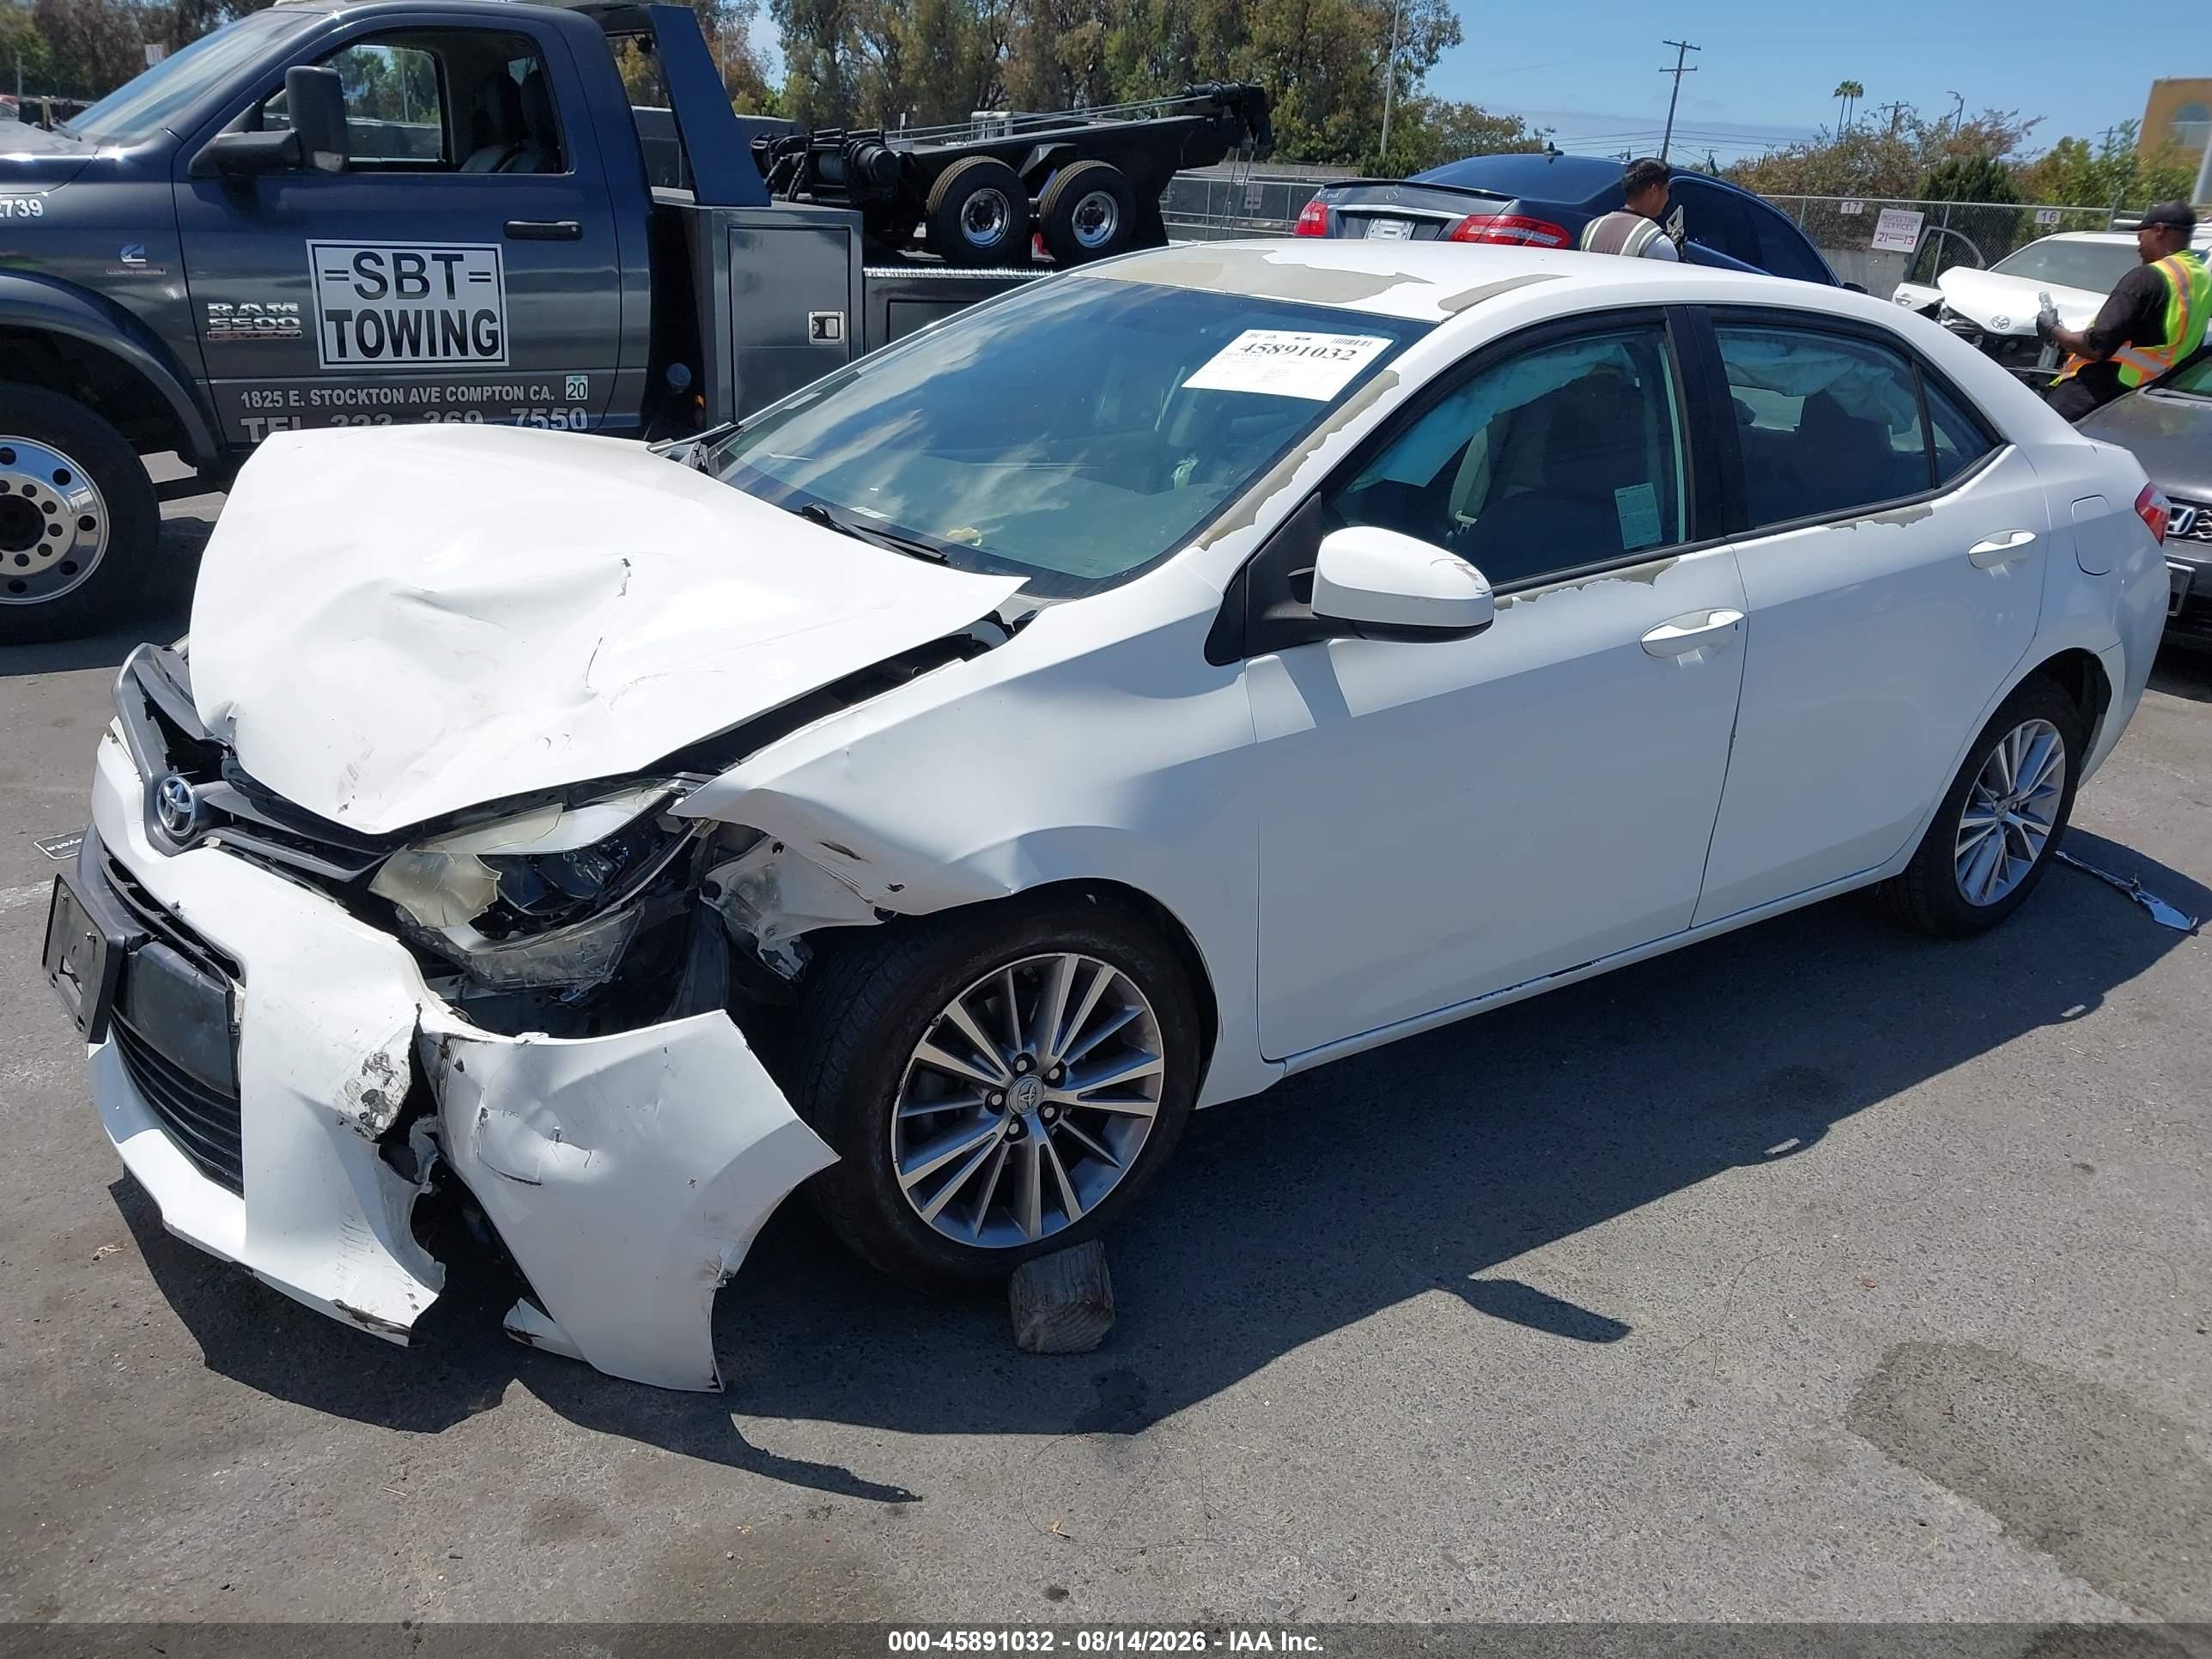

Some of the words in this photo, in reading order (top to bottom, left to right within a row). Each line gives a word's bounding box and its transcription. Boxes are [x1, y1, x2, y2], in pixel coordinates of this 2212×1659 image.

[2041, 211, 2057, 222] 16
[207, 301, 300, 317] RAM
[208, 316, 301, 331] 5500
[325, 308, 500, 359] TOWING
[1239, 343, 1358, 361] 45891032
[240, 391, 283, 408] 1825
[289, 390, 306, 406] E.
[309, 387, 404, 406] STOCKTON
[408, 386, 441, 404] AVE
[445, 386, 525, 403] COMPTON
[529, 385, 555, 401] CA.
[568, 382, 586, 398] 20
[510, 405, 588, 430] 7550
